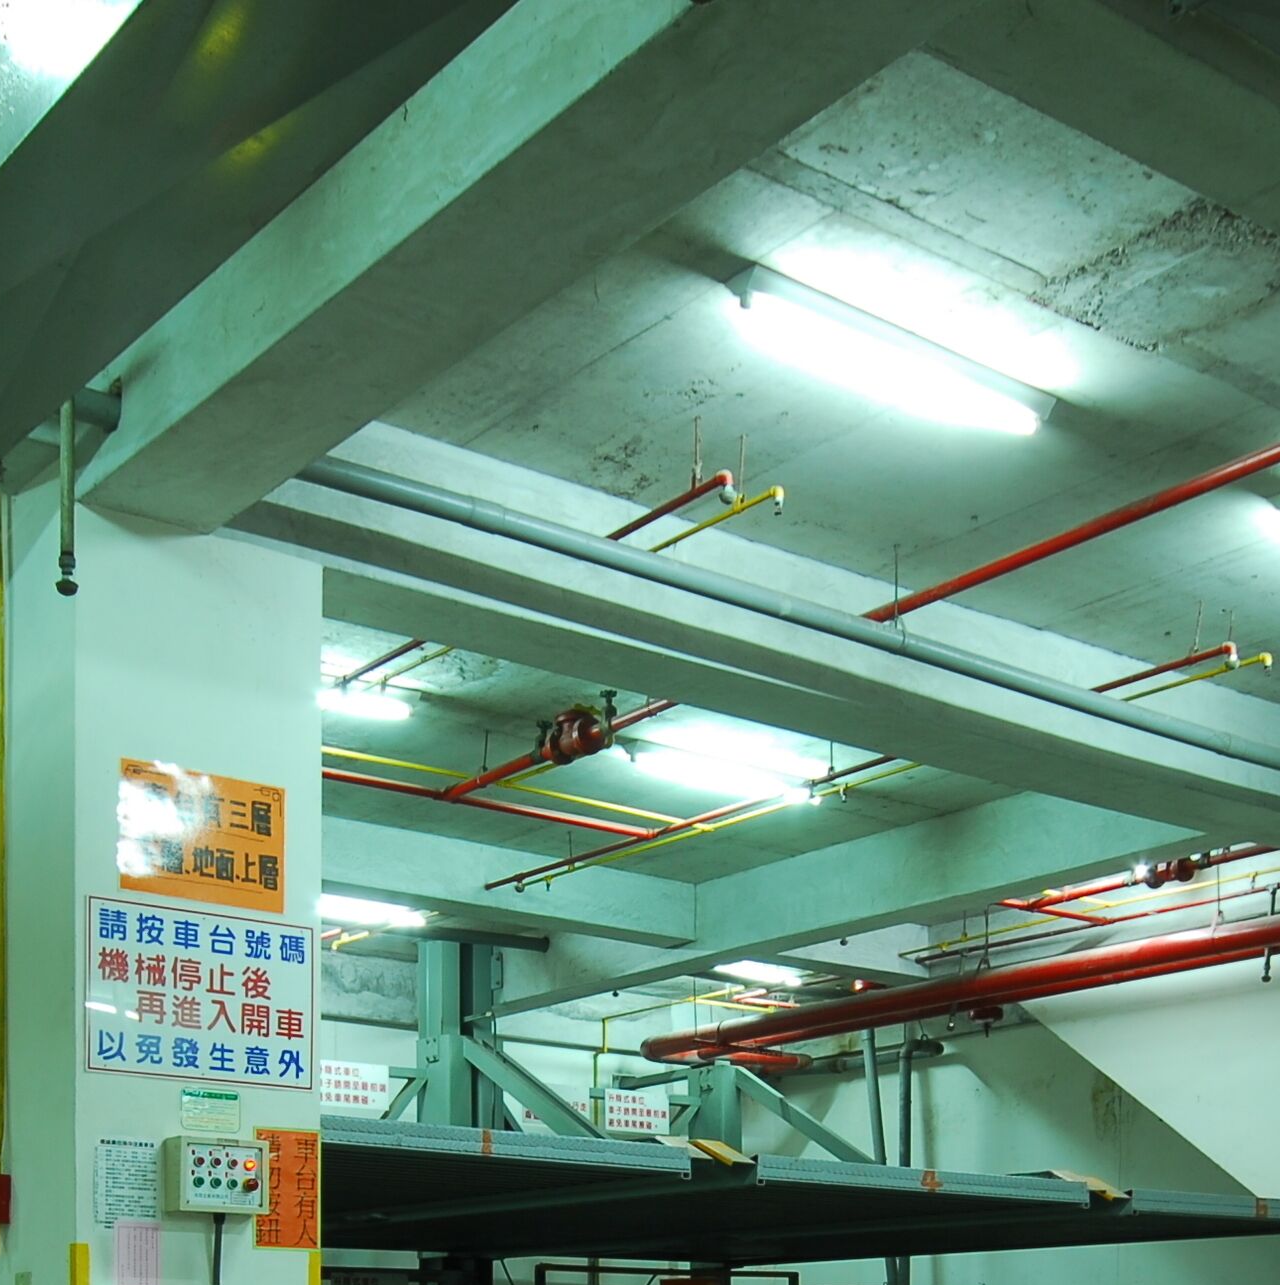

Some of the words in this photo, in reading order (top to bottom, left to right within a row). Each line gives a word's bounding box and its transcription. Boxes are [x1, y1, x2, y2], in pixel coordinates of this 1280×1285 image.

[99, 907, 305, 965] 請按車台號碼
[98, 946, 271, 1001] 機械停止後
[135, 989, 305, 1041] 再進入開車
[97, 1029, 305, 1080] 以免發生意外
[293, 1137, 318, 1247] 車台有人
